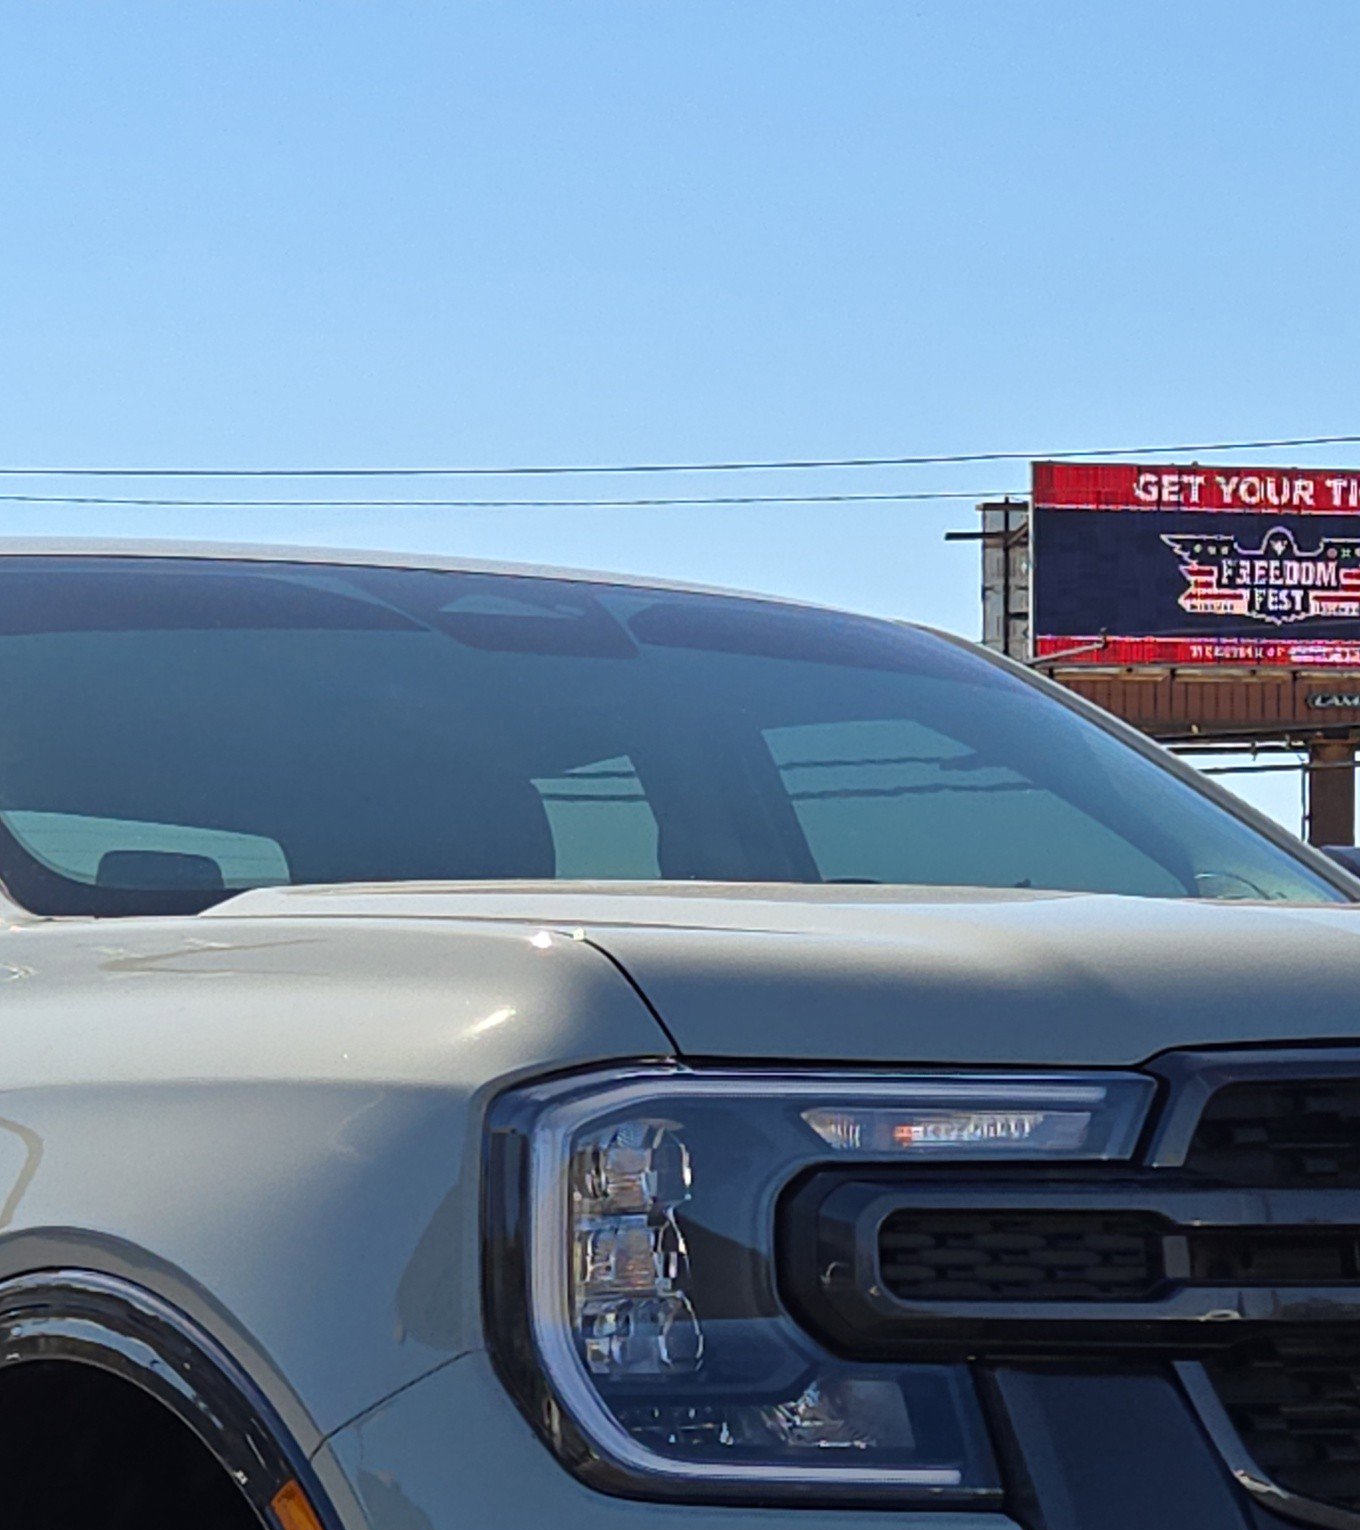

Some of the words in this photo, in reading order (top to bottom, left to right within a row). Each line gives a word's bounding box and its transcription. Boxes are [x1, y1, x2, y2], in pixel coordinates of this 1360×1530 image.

[1133, 472, 1206, 503] GET
[1215, 475, 1316, 507] YOUR
[1220, 559, 1339, 587] FREEDOM
[1253, 588, 1305, 611] FEST
